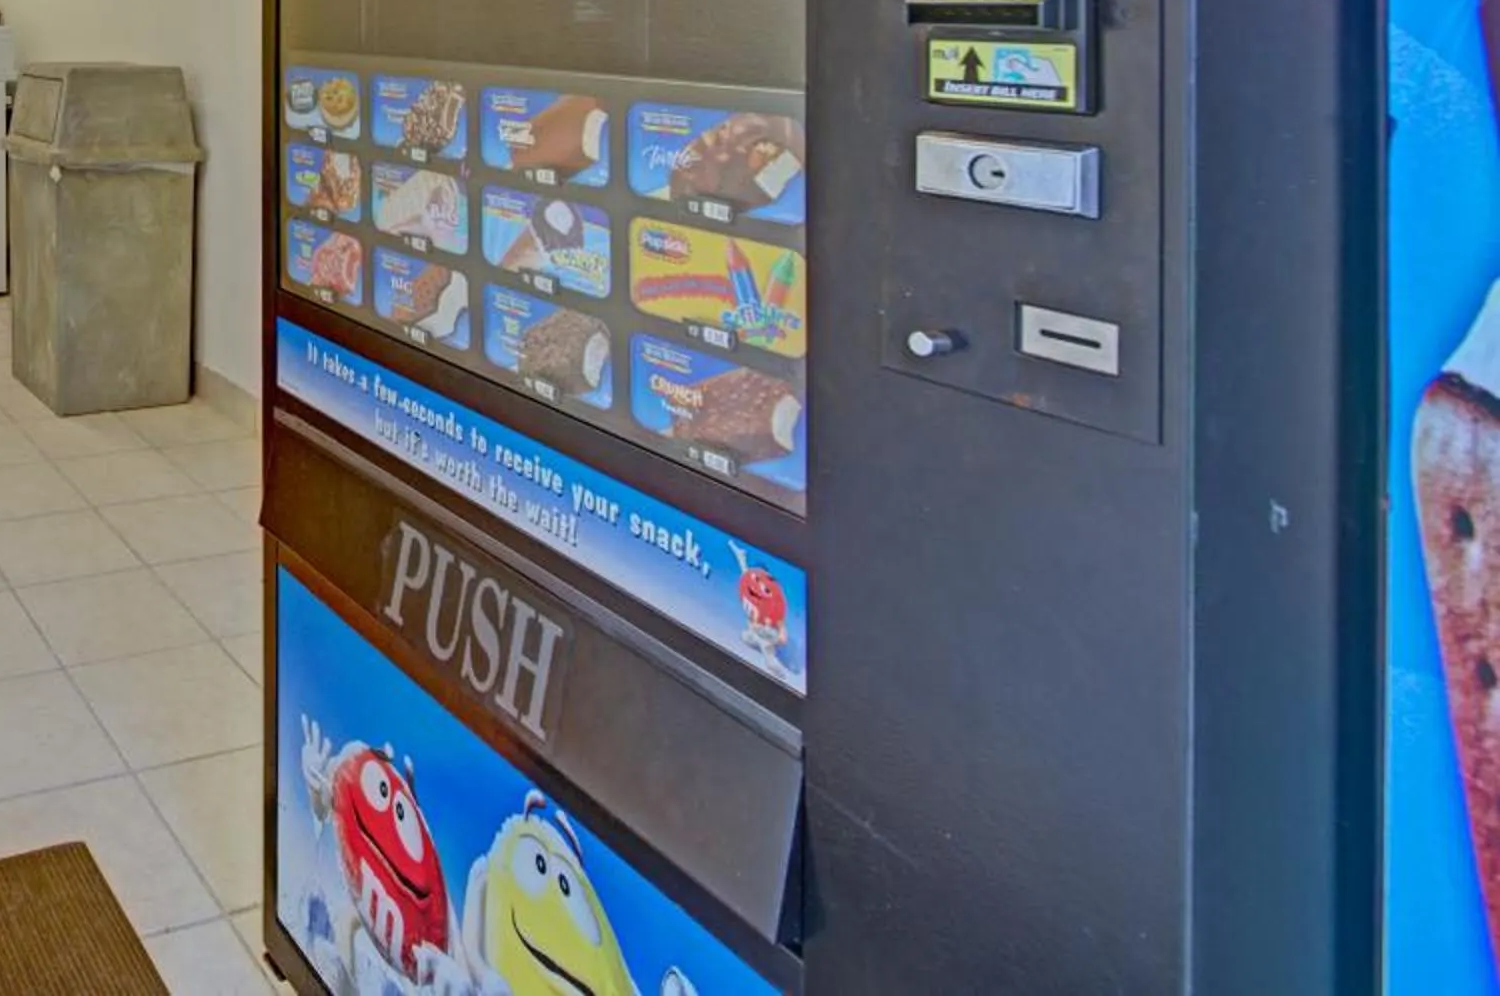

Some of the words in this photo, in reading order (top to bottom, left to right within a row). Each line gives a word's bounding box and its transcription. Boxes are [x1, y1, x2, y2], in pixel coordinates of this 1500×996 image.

[323, 349, 355, 385] takes
[360, 375, 369, 392] a
[373, 373, 399, 408] few
[402, 396, 464, 444] seconds
[471, 427, 488, 455] to
[495, 444, 564, 496] receive
[572, 482, 621, 526] your
[630, 512, 712, 578] snack,
[373, 408, 399, 446] but
[436, 450, 484, 495] worth
[489, 474, 520, 513] the
[525, 500, 579, 547] wait!
[649, 373, 704, 407] CRUNCH
[380, 520, 564, 741] PUSH
